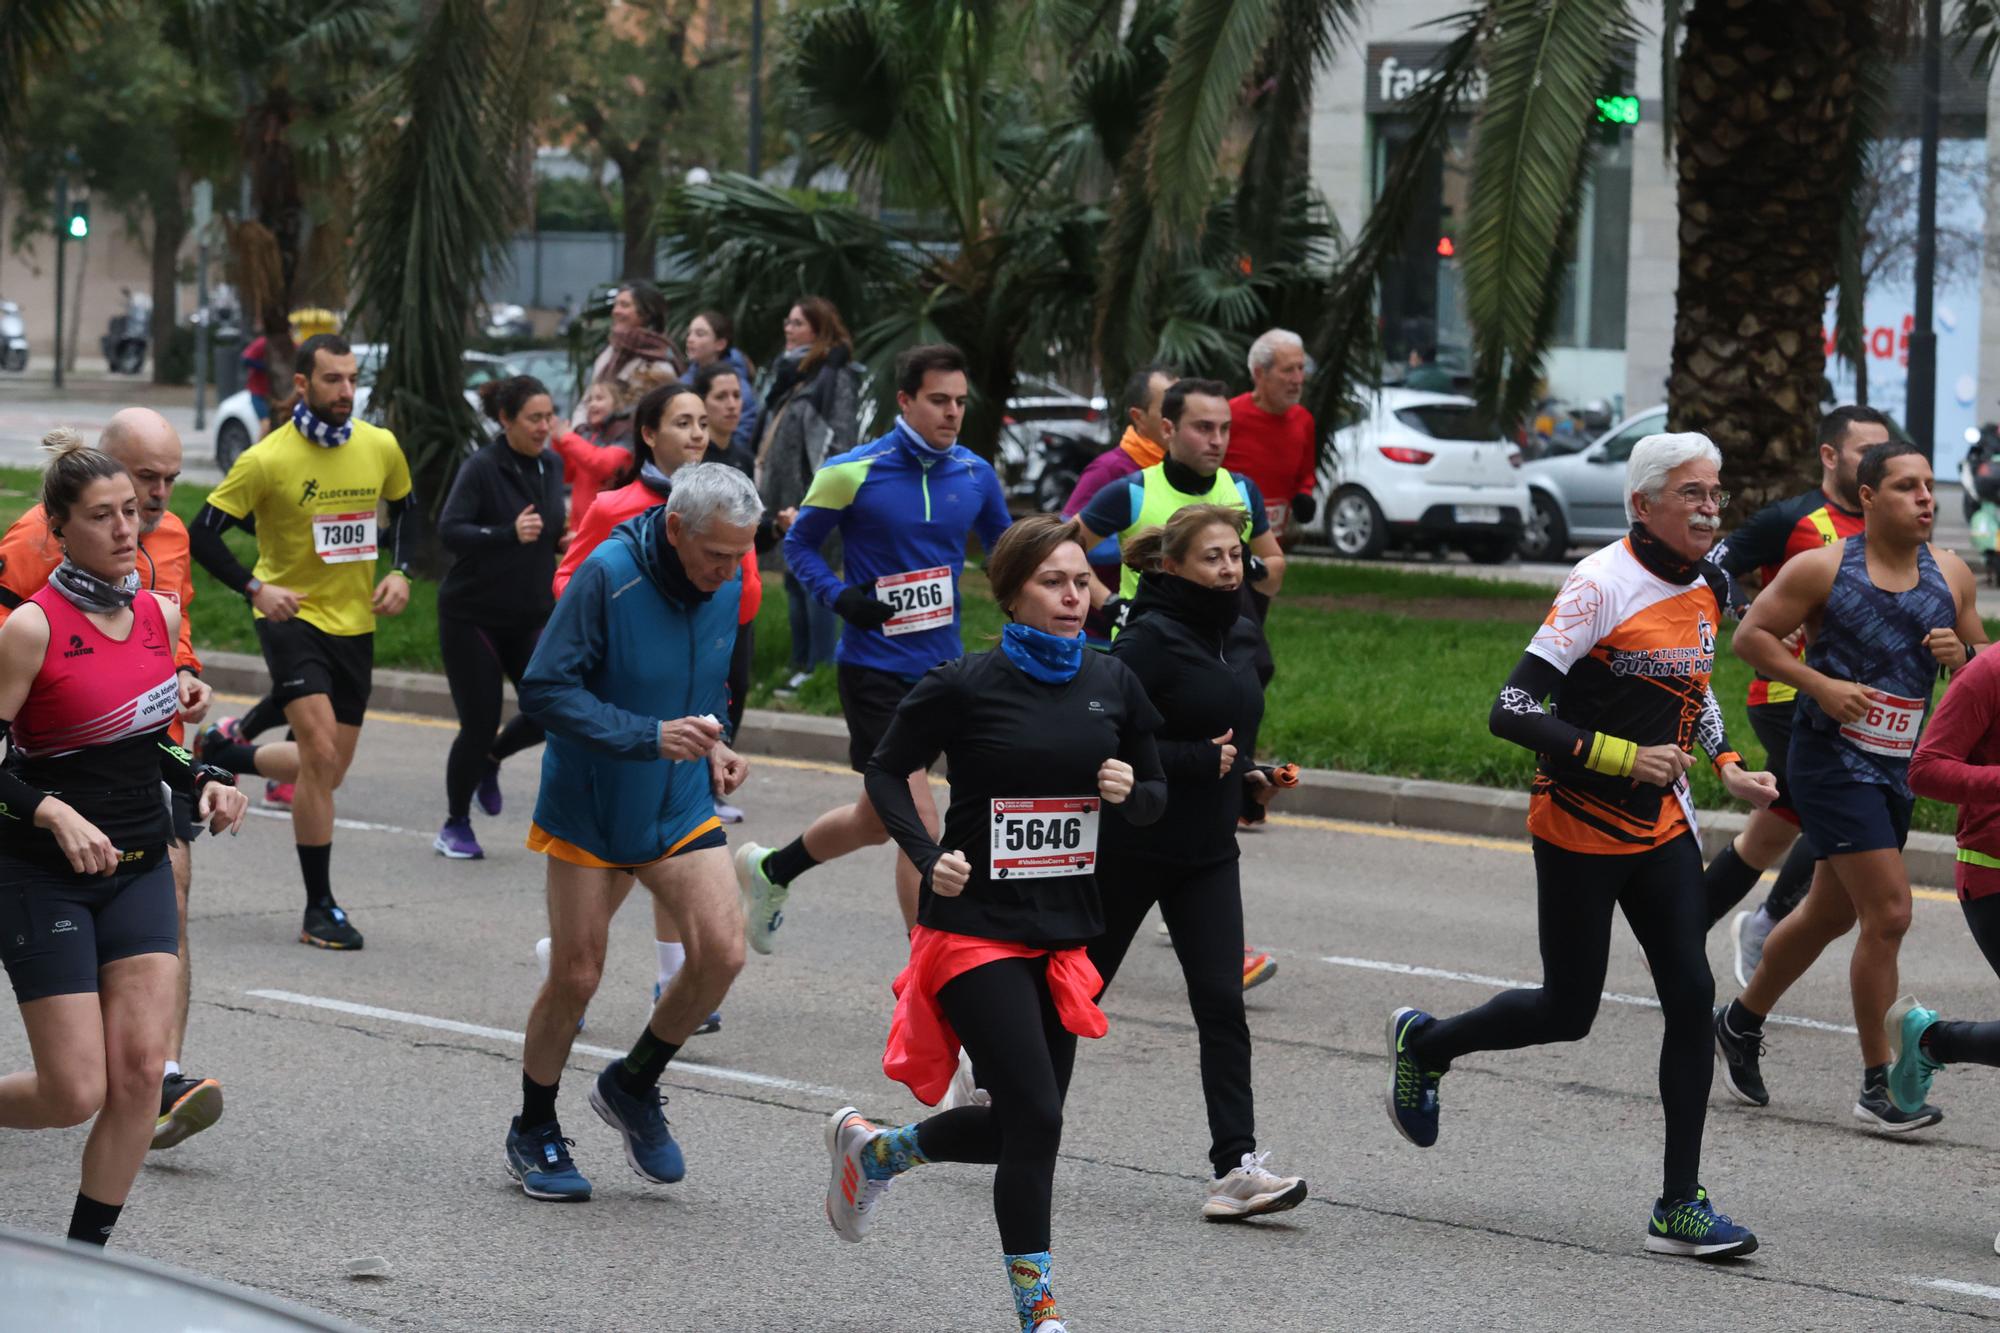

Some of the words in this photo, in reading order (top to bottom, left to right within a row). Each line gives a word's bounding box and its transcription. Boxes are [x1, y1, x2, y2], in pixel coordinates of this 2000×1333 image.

[322, 524, 365, 546] 7309
[888, 583, 943, 612] 5266
[64, 647, 94, 658] VIATOR
[1614, 651, 1649, 660] CLUB
[1651, 647, 1700, 659] ATLETISME
[1610, 660, 1674, 677] QUART
[1675, 660, 1692, 675] DE
[148, 692, 161, 702] Club
[142, 704, 156, 715] VON
[1865, 706, 1911, 732] 615
[1006, 818, 1081, 851] 5646
